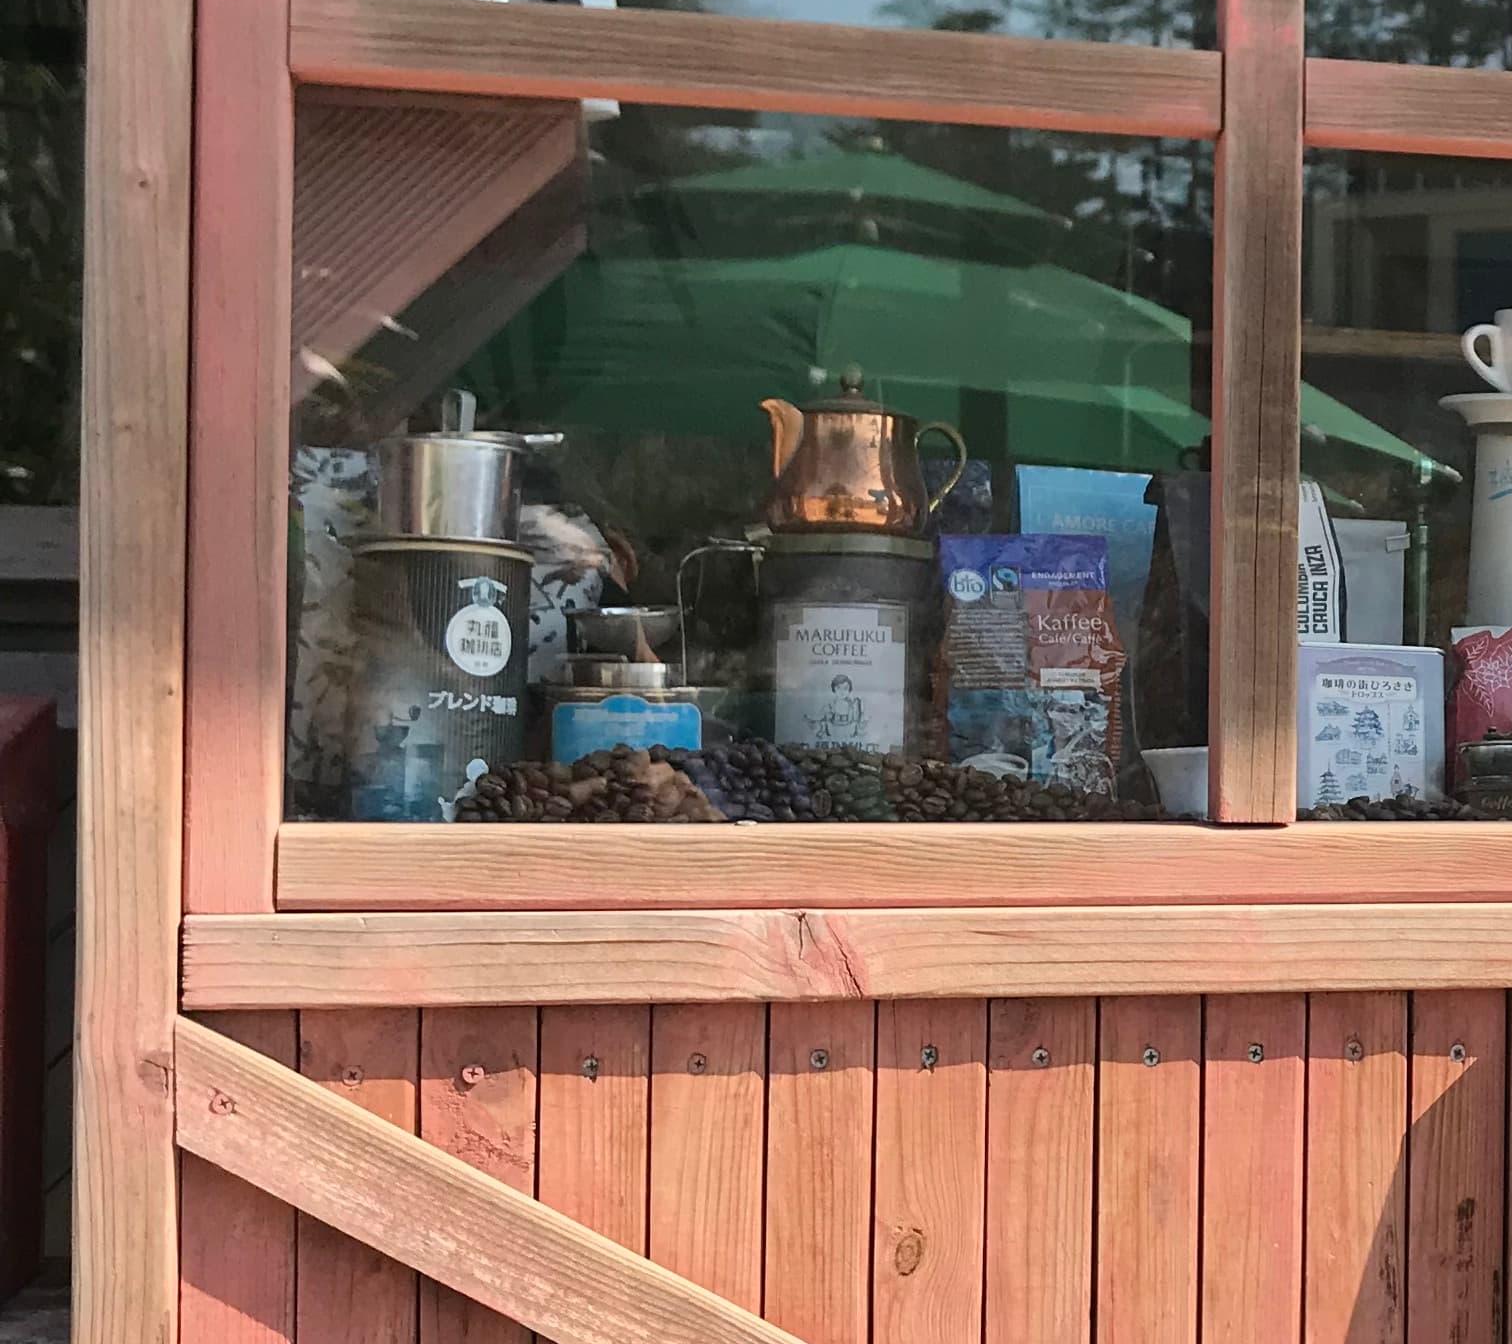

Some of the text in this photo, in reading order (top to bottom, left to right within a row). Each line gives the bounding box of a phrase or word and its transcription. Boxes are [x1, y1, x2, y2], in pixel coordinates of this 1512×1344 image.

[954, 575, 984, 594] bio
[1304, 544, 1329, 634] CAUCA INZA
[1038, 614, 1103, 631] Kaffee
[796, 628, 886, 643] MARUFUKU
[812, 642, 868, 657] COFFEE
